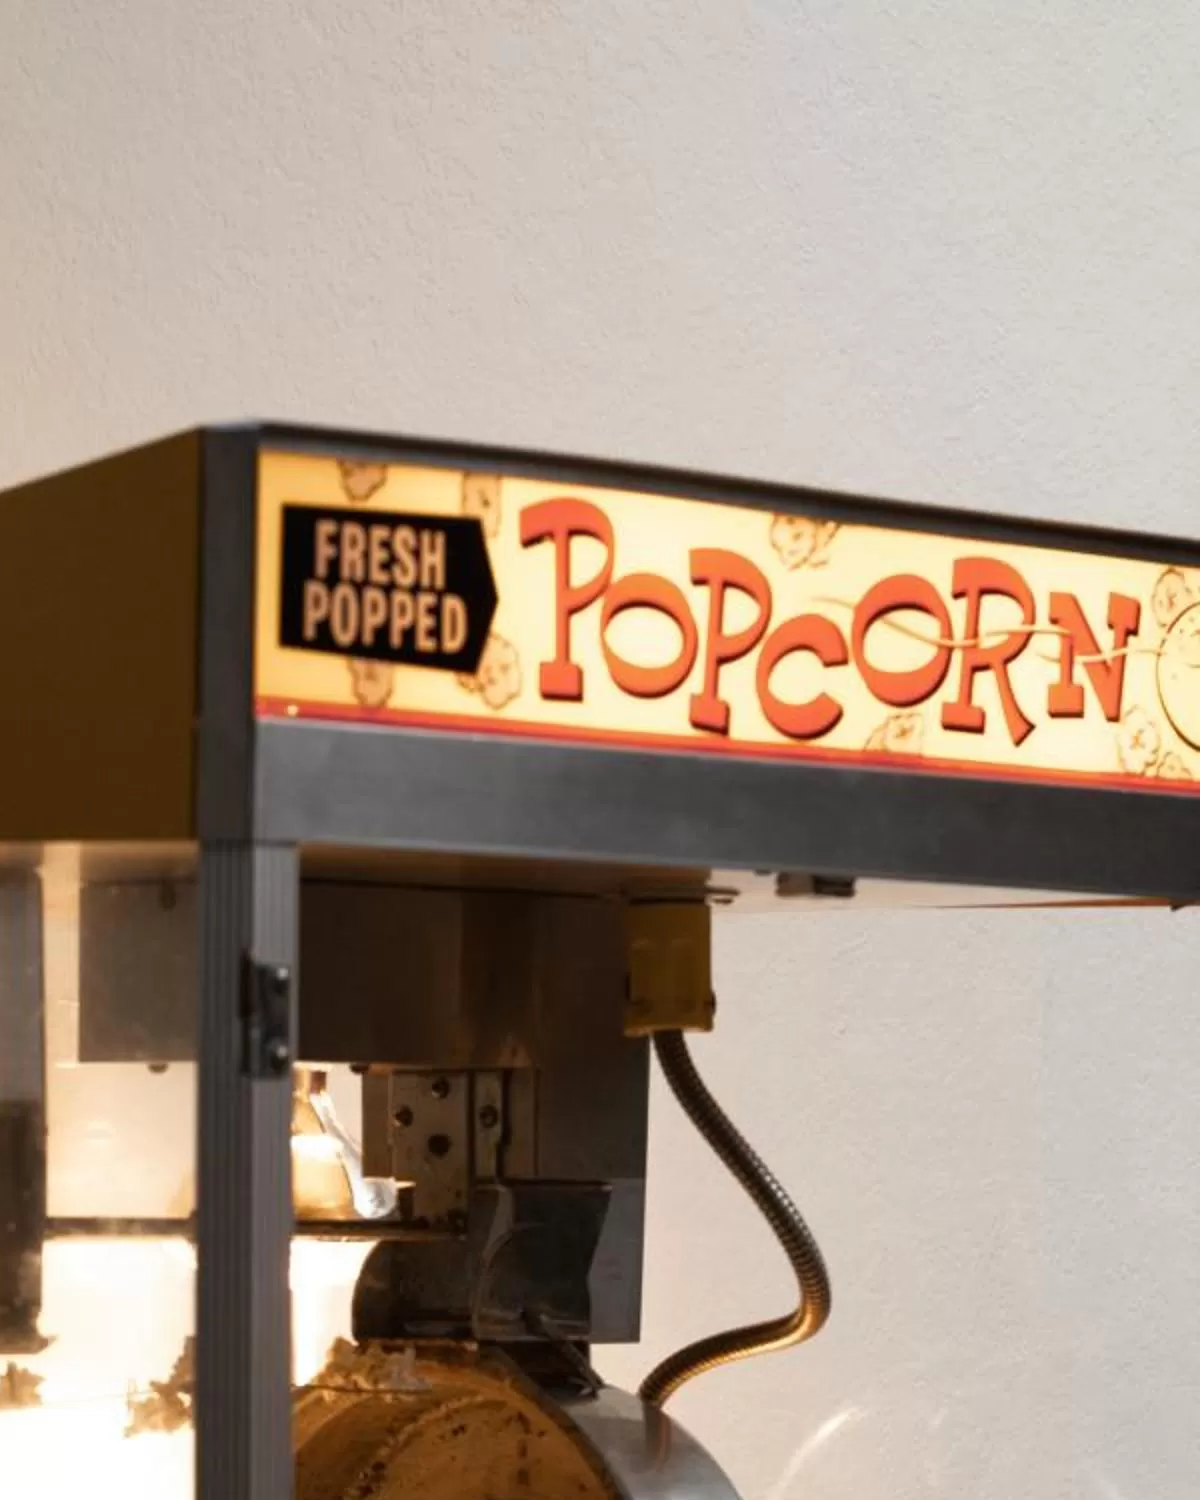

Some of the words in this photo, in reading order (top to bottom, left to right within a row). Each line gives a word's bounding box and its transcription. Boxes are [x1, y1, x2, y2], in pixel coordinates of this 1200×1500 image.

[313, 517, 446, 590] FRESH
[302, 584, 469, 655] POPPED
[519, 497, 1142, 746] POPCORN
